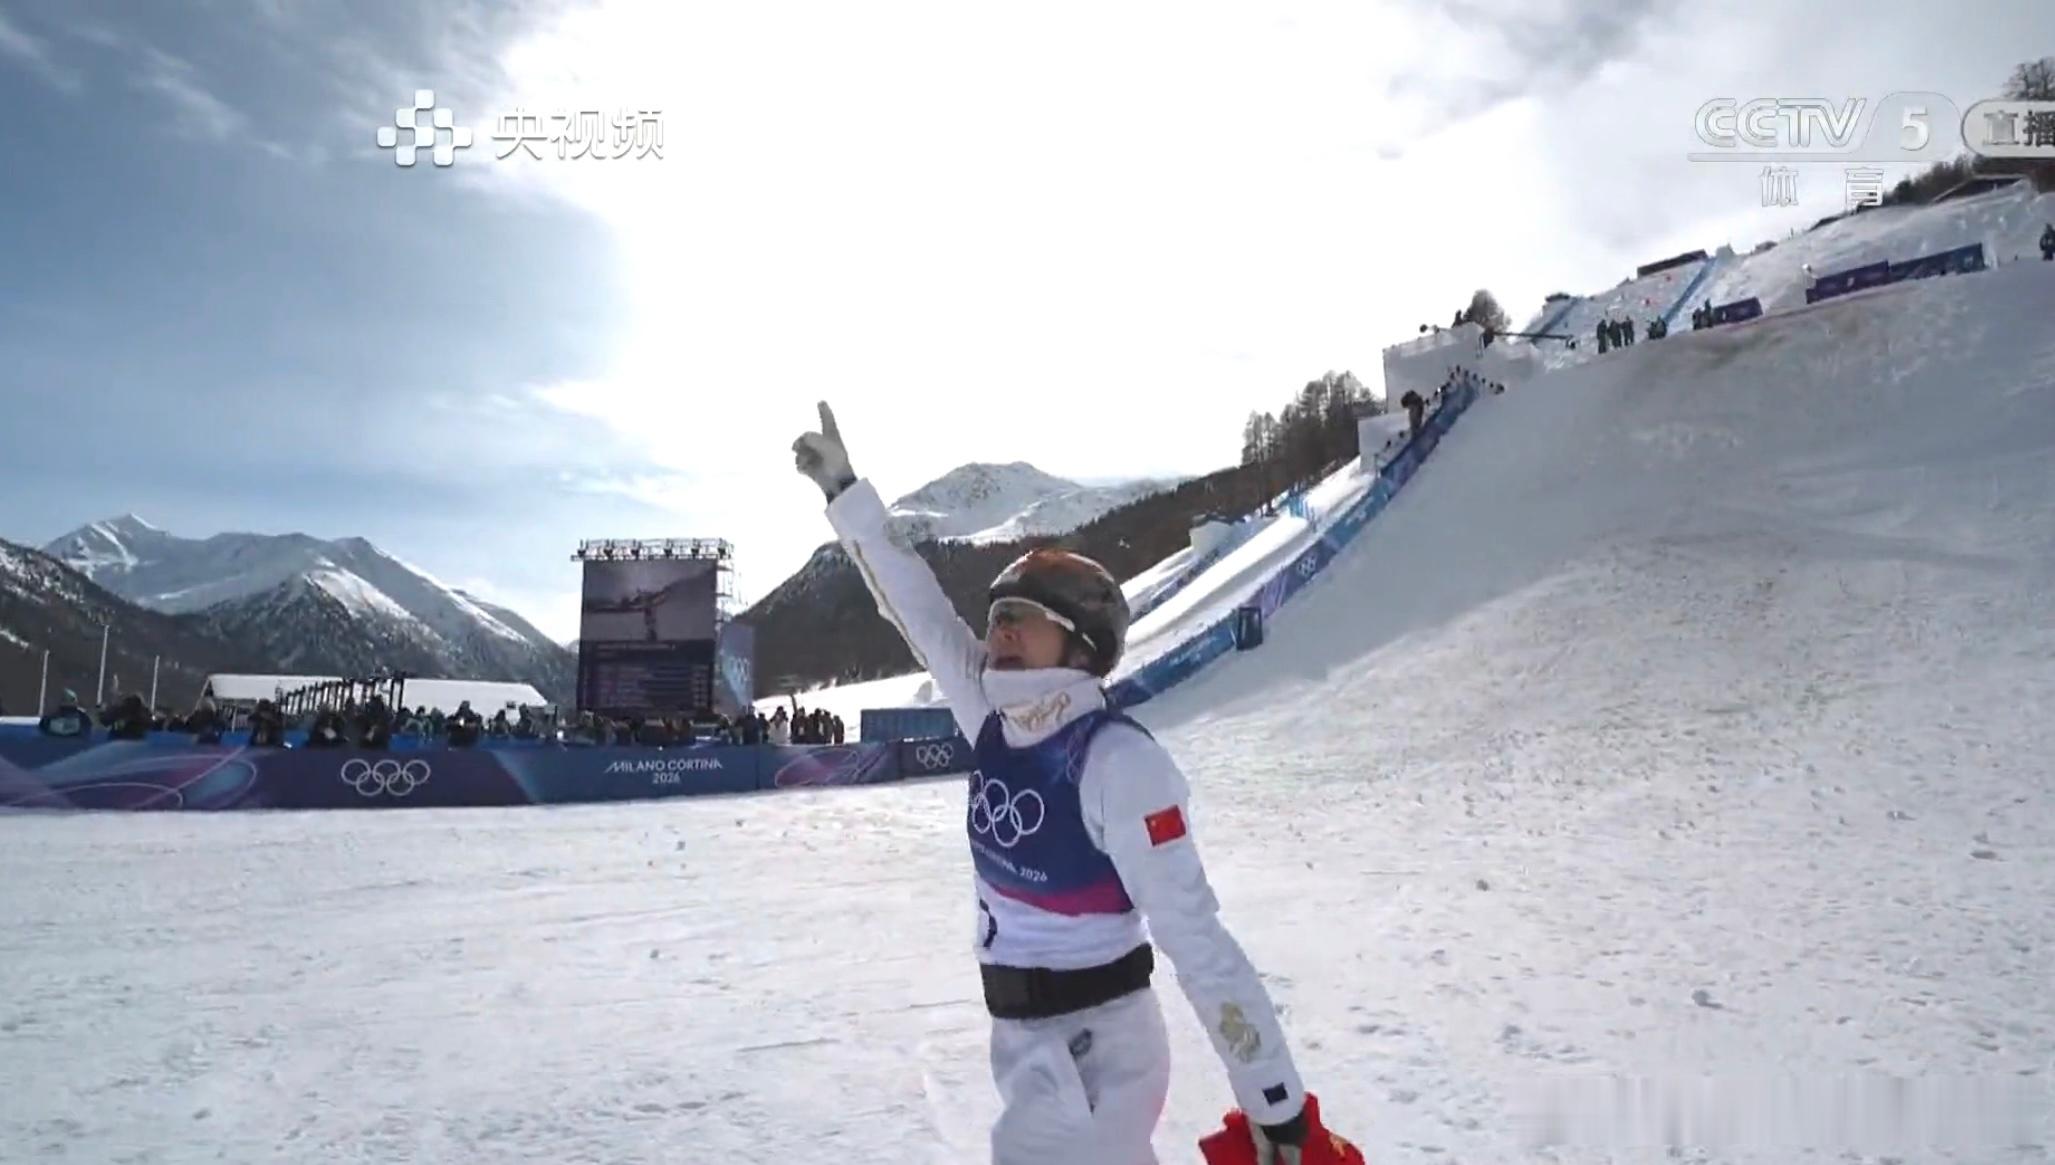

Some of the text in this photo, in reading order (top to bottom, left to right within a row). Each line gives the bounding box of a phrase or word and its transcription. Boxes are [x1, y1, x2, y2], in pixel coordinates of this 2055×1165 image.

[603, 758, 723, 774] MILANO CORTINA
[652, 771, 681, 784] 2026
[1020, 866, 1048, 882] 2026
